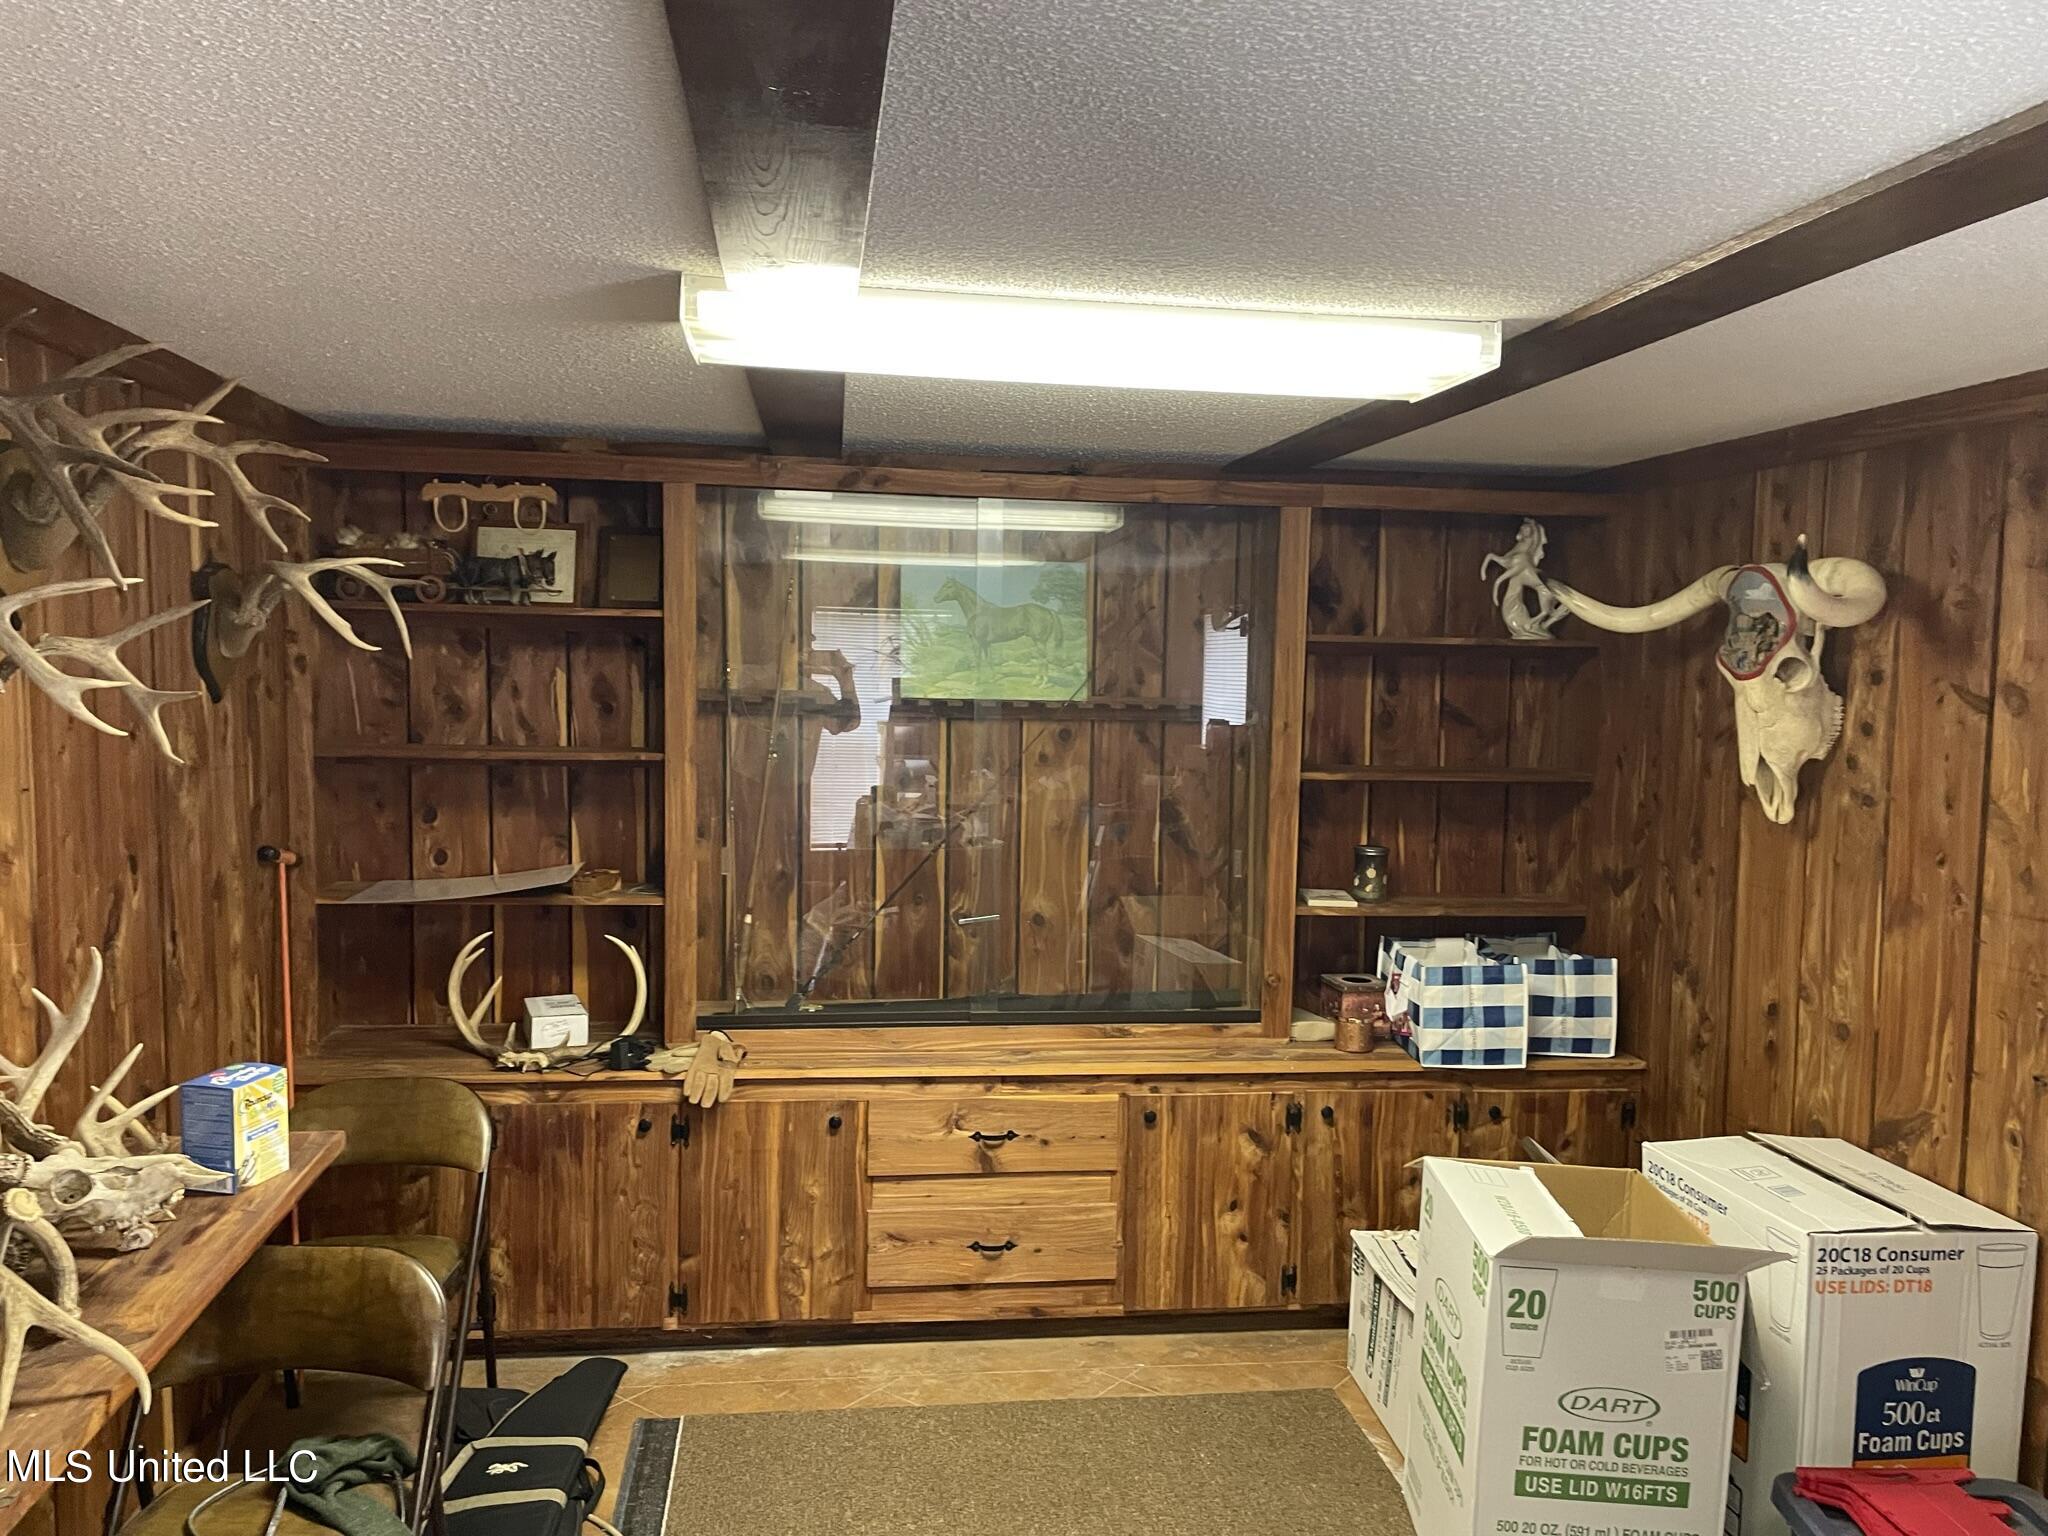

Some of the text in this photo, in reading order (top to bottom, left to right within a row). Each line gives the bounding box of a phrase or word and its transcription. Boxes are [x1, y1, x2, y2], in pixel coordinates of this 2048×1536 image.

[1677, 1177, 1728, 1216] Consumer
[1816, 1247, 1964, 1263] 20C18 Consumer
[1816, 1265, 1930, 1277] 25 Packages of 20 Cups
[1693, 1279, 1740, 1303] 500
[1815, 1279, 1933, 1294] USE LIDS: DT18
[1506, 1288, 1547, 1320] 20
[1694, 1304, 1737, 1320] CUPS
[1895, 1378, 1938, 1393] WinCup
[1570, 1395, 1649, 1415] DART
[1521, 1425, 1689, 1463] FOAM CUPS
[1858, 1429, 1965, 1454] Foam Cups
[1519, 1455, 1689, 1478] FOR HOT OR COLD BEVERAGES
[1525, 1475, 1678, 1503] USE LID W16FTS
[1496, 1520, 1518, 1533] 500
[1521, 1521, 1536, 1534] 20
